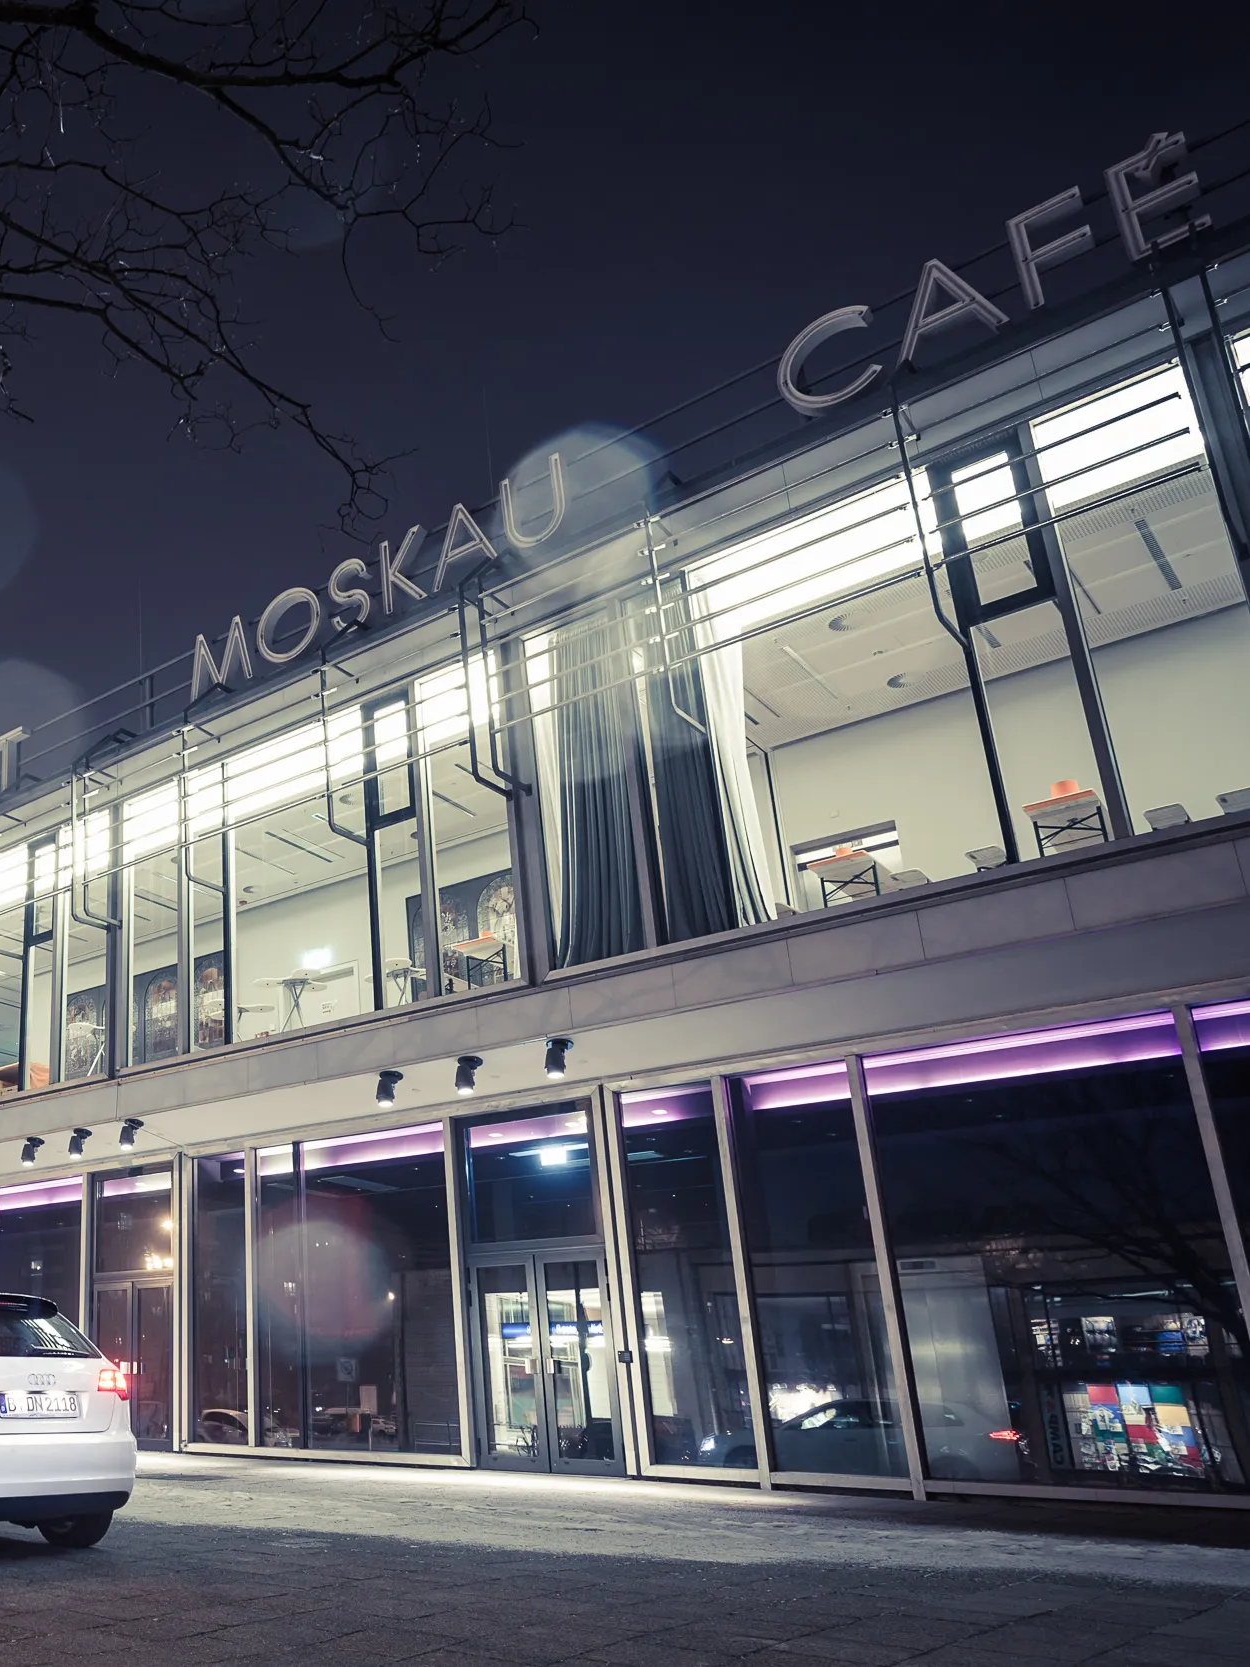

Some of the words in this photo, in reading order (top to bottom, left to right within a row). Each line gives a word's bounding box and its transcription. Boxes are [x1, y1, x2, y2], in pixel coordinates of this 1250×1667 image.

[777, 132, 1212, 417] CAFÉ
[191, 453, 566, 702] MOSKAU
[7, 1396, 17, 1412] B
